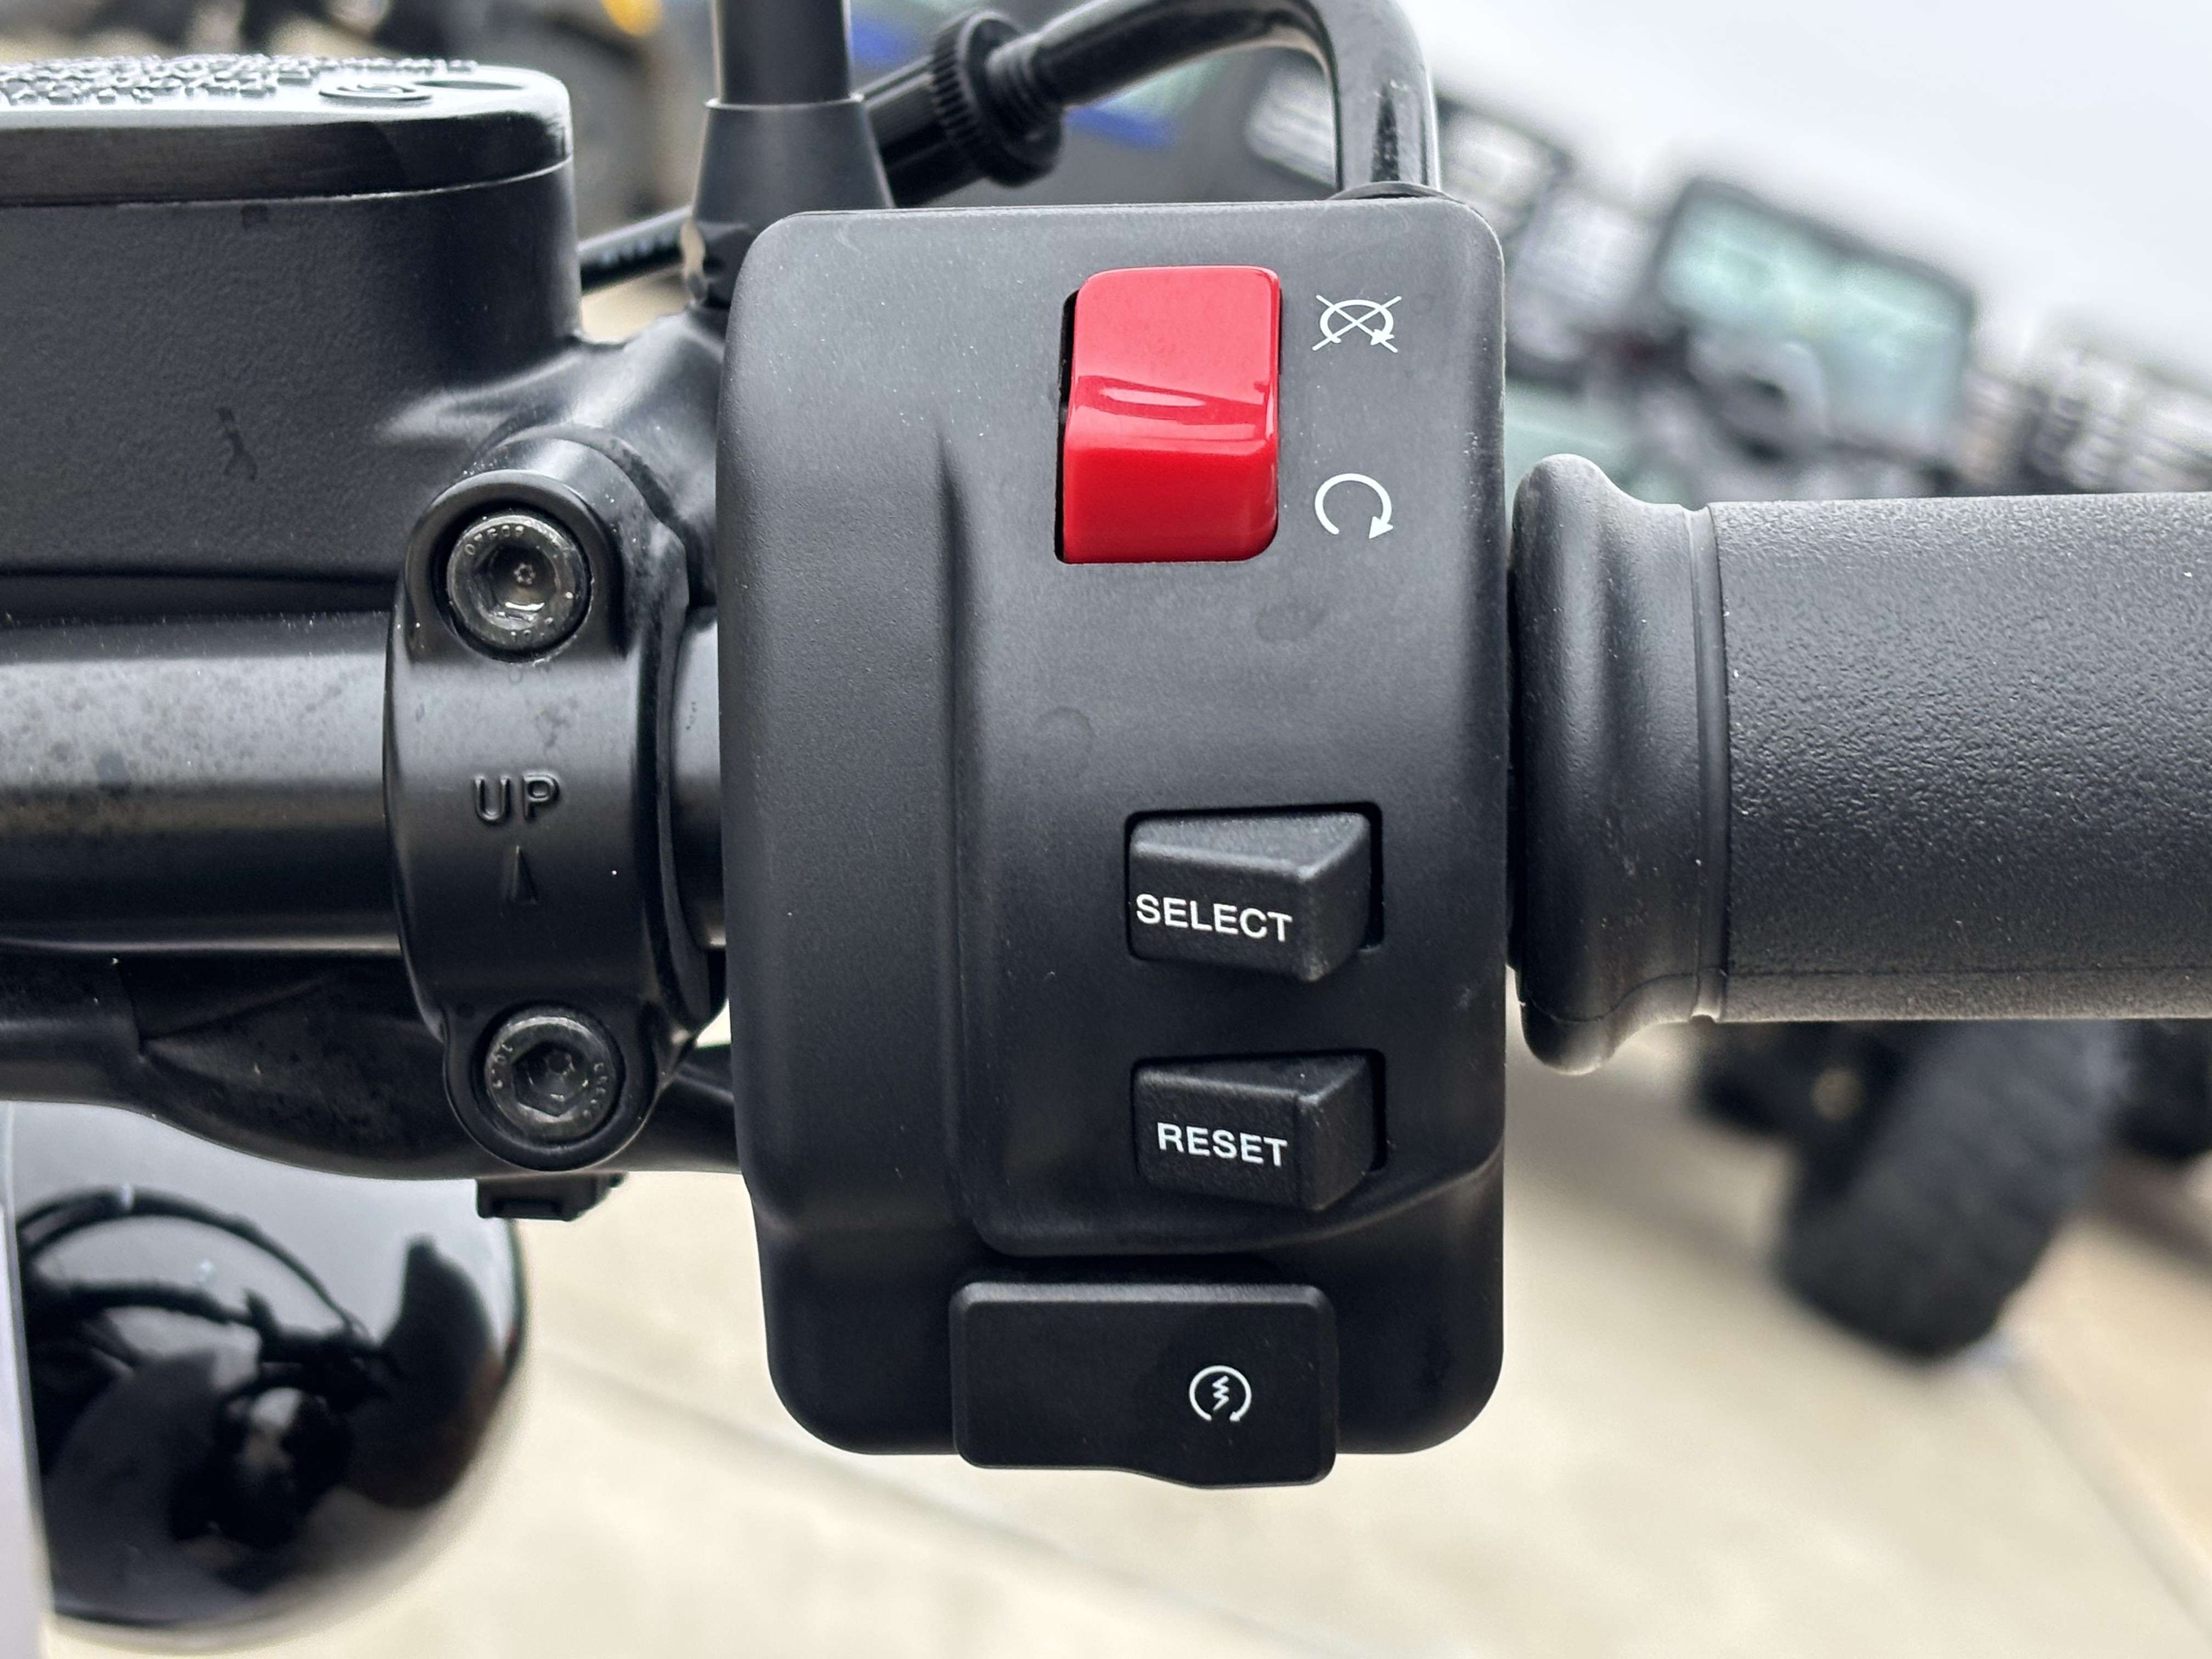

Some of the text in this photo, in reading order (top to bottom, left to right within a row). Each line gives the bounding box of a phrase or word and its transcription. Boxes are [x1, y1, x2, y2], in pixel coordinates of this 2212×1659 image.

[474, 771, 560, 822] UP
[1136, 893, 1293, 943] SELECT
[1156, 1121, 1289, 1167] RESET
